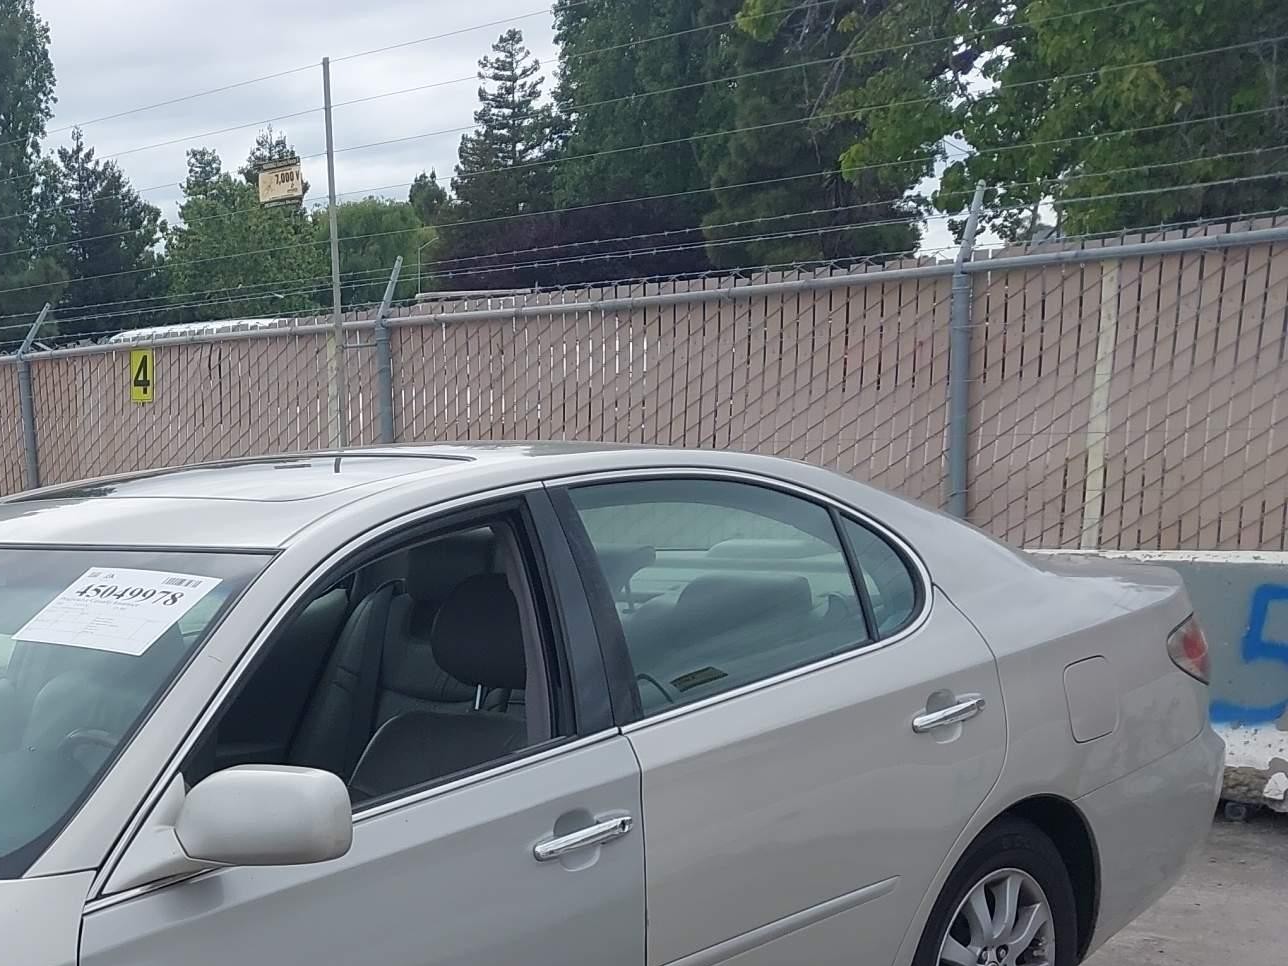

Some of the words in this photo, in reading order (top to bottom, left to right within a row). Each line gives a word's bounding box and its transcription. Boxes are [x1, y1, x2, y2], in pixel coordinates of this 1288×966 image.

[134, 354, 151, 395] 4
[75, 583, 185, 607] 45049978
[1209, 583, 1288, 726] 5
